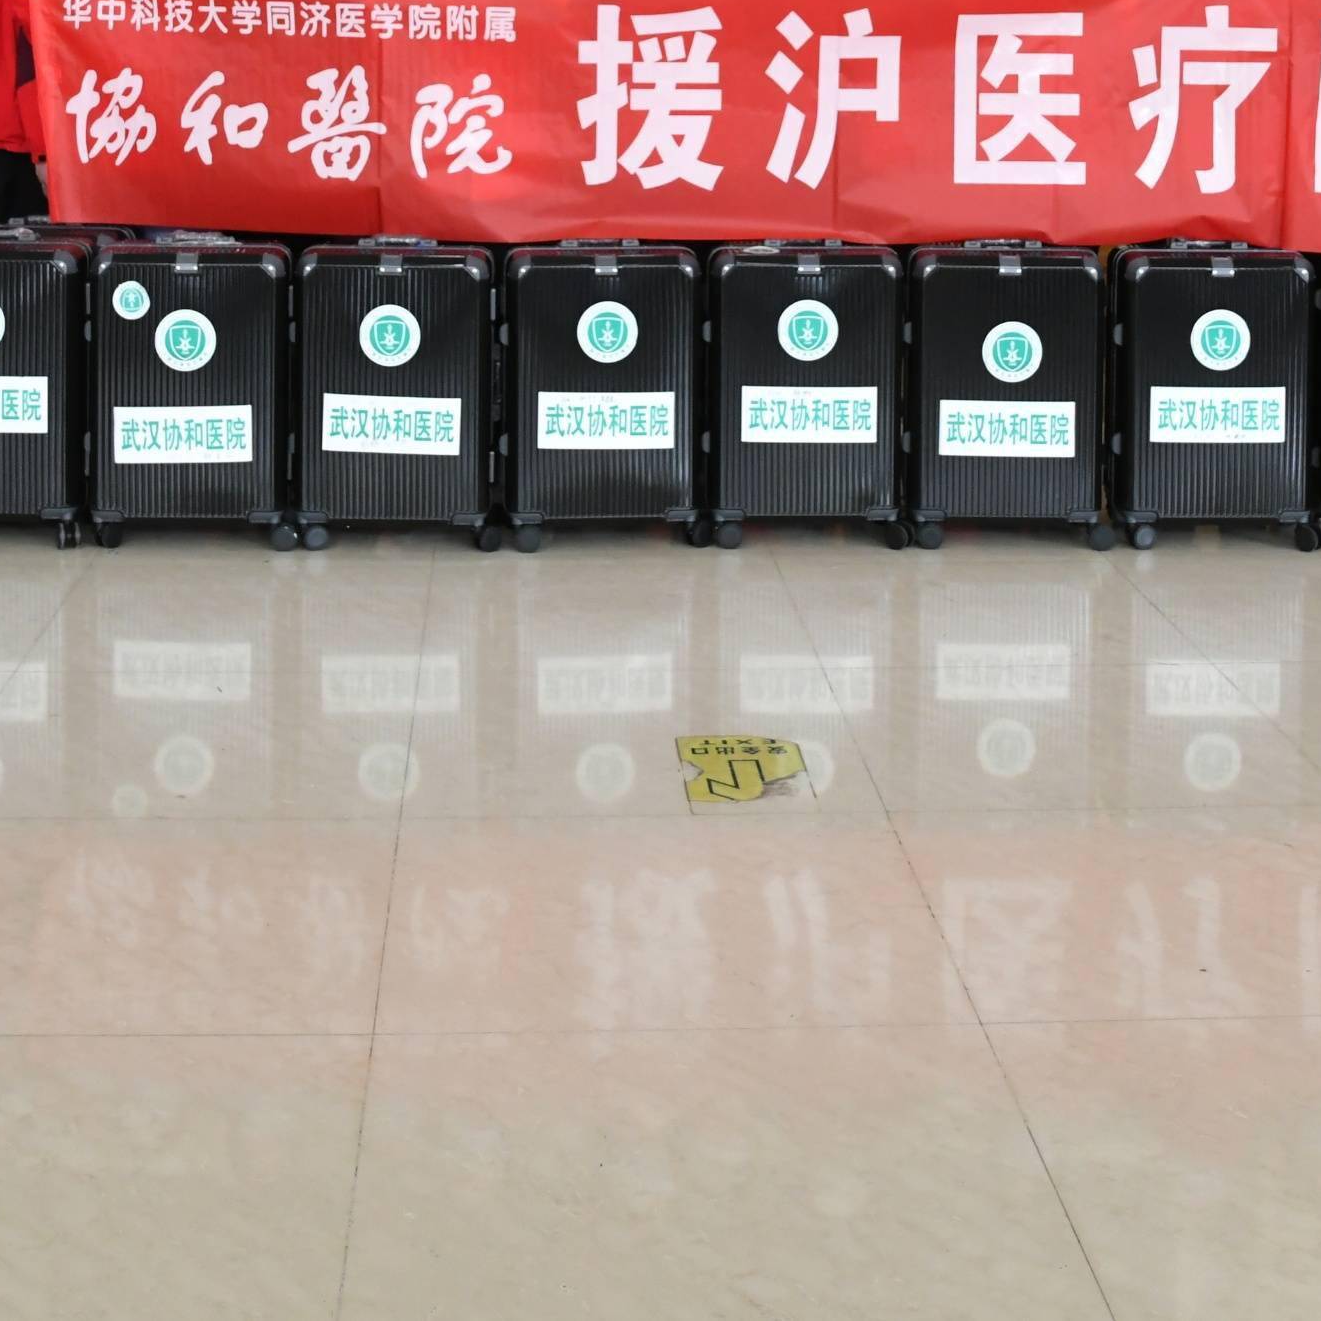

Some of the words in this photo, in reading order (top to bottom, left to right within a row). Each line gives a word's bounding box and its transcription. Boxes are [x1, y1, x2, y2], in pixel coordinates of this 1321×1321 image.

[64, 66, 514, 181] 協和醫院
[327, 407, 456, 442] 武汉协和医院
[545, 405, 670, 437] 武汉协和医院
[748, 398, 873, 431] 武汉协和医院
[945, 412, 1070, 446] 武汉协和医院
[1157, 398, 1282, 431] 武汉协和医院
[120, 418, 247, 452] 武汉协和医院
